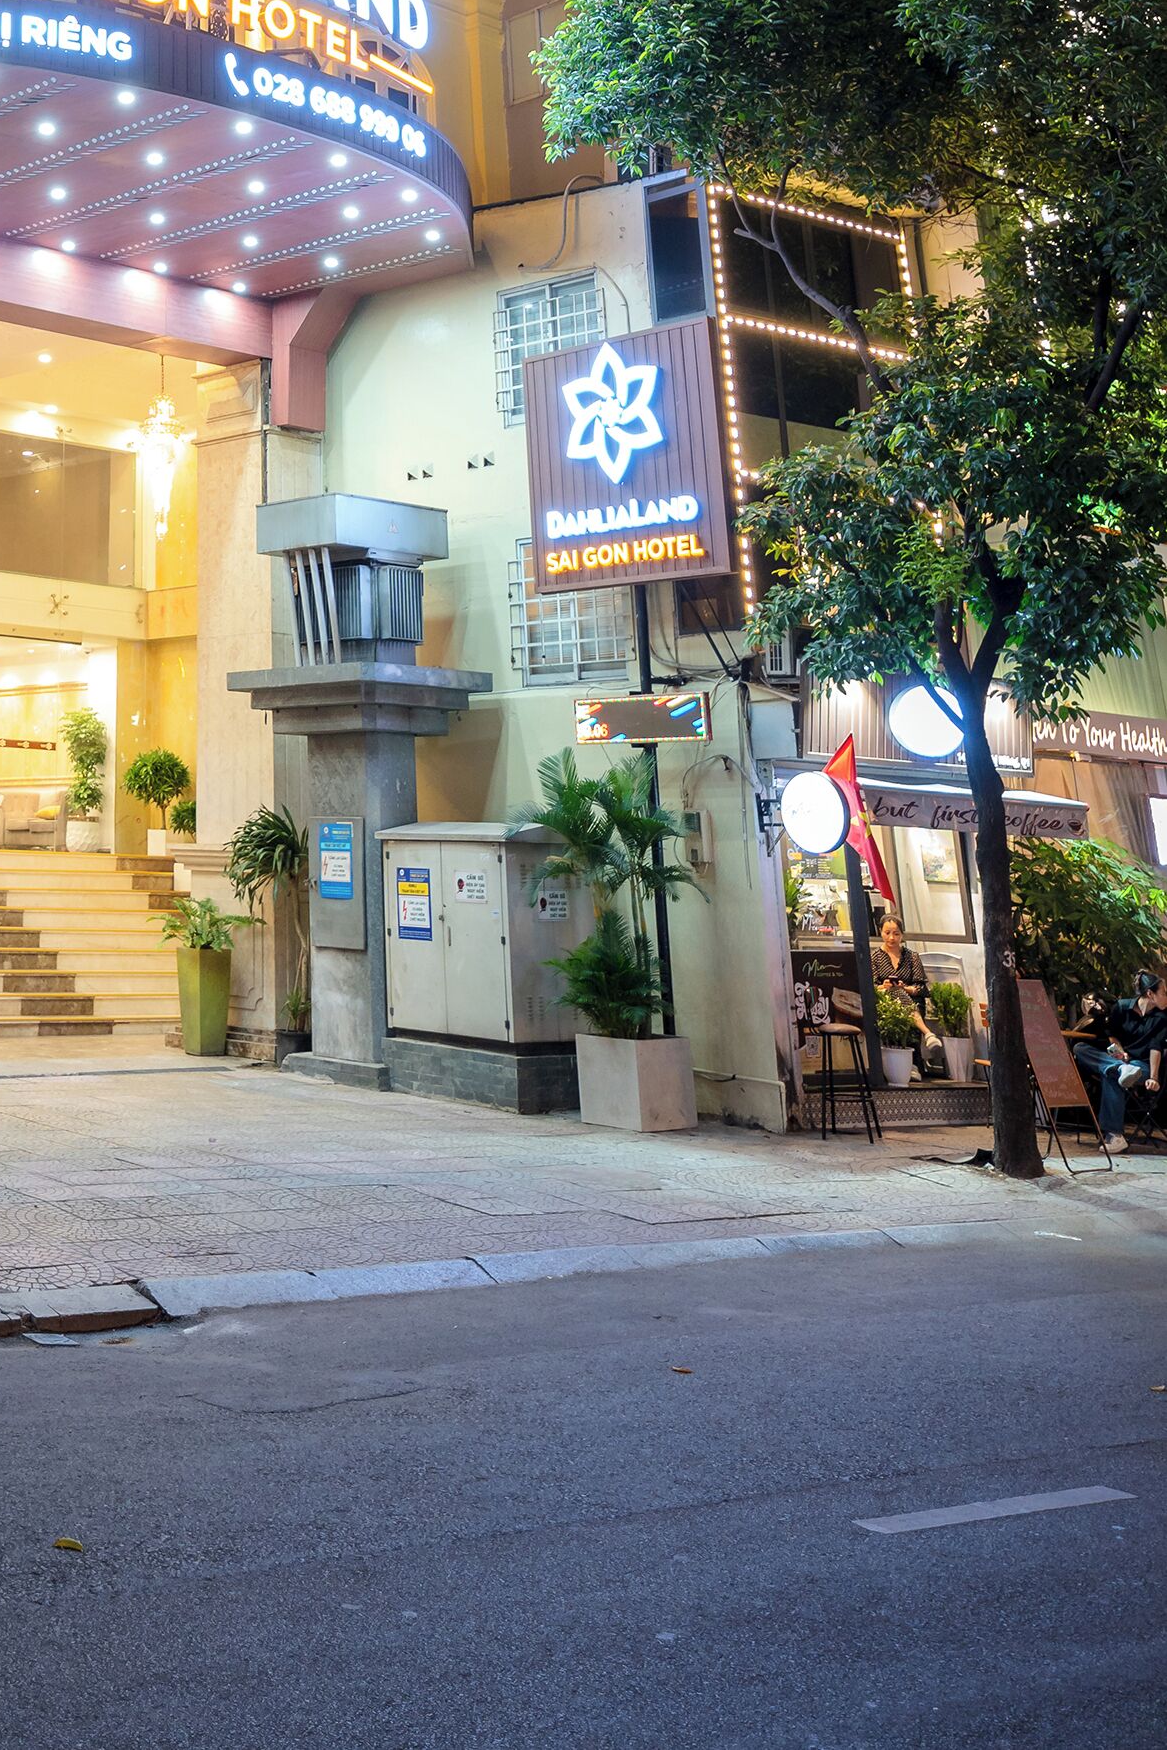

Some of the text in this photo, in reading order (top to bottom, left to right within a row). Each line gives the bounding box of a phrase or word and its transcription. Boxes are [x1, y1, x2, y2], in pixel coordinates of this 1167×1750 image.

[21, 15, 133, 61] RIÊNG
[252, 67, 306, 107] 028
[401, 123, 427, 158] 06
[546, 534, 705, 574] SAI GON HOTEL
[1081, 717, 1117, 750] Your
[1119, 721, 1167, 757] Health
[872, 796, 919, 819] but
